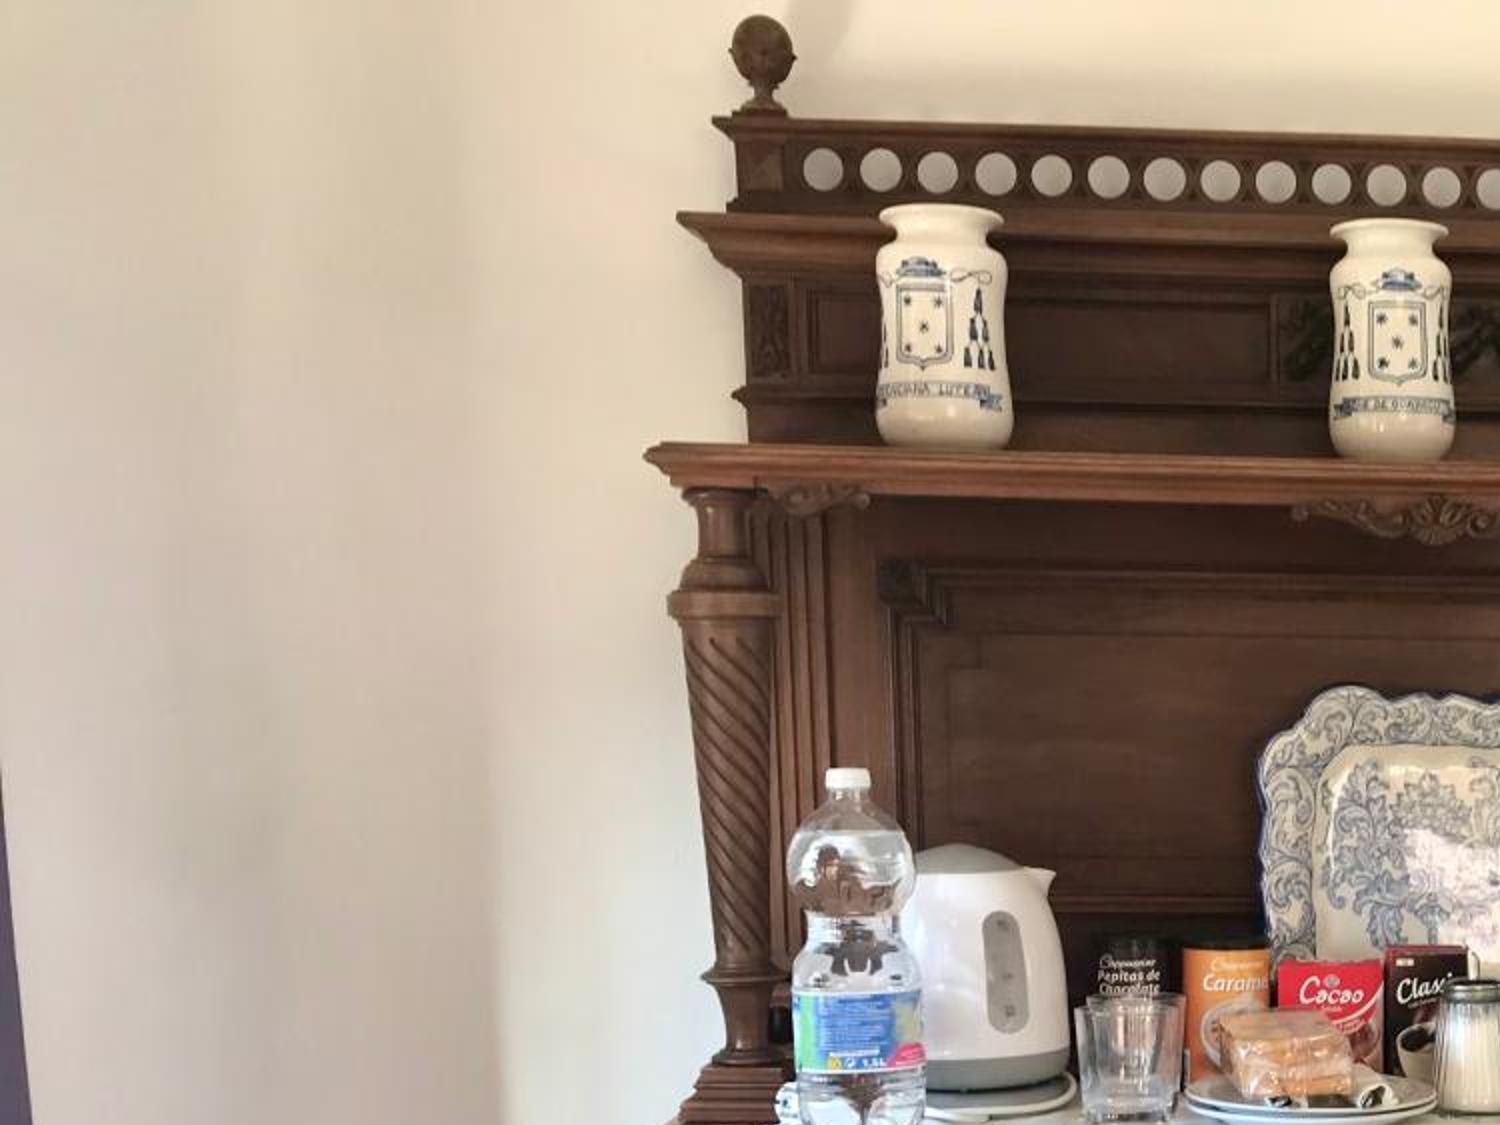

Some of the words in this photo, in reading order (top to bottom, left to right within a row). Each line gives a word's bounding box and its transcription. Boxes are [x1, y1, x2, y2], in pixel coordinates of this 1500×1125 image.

[1098, 970, 1145, 983] Pepitas
[1146, 970, 1162, 982] de
[1299, 975, 1365, 1005] Cacao
